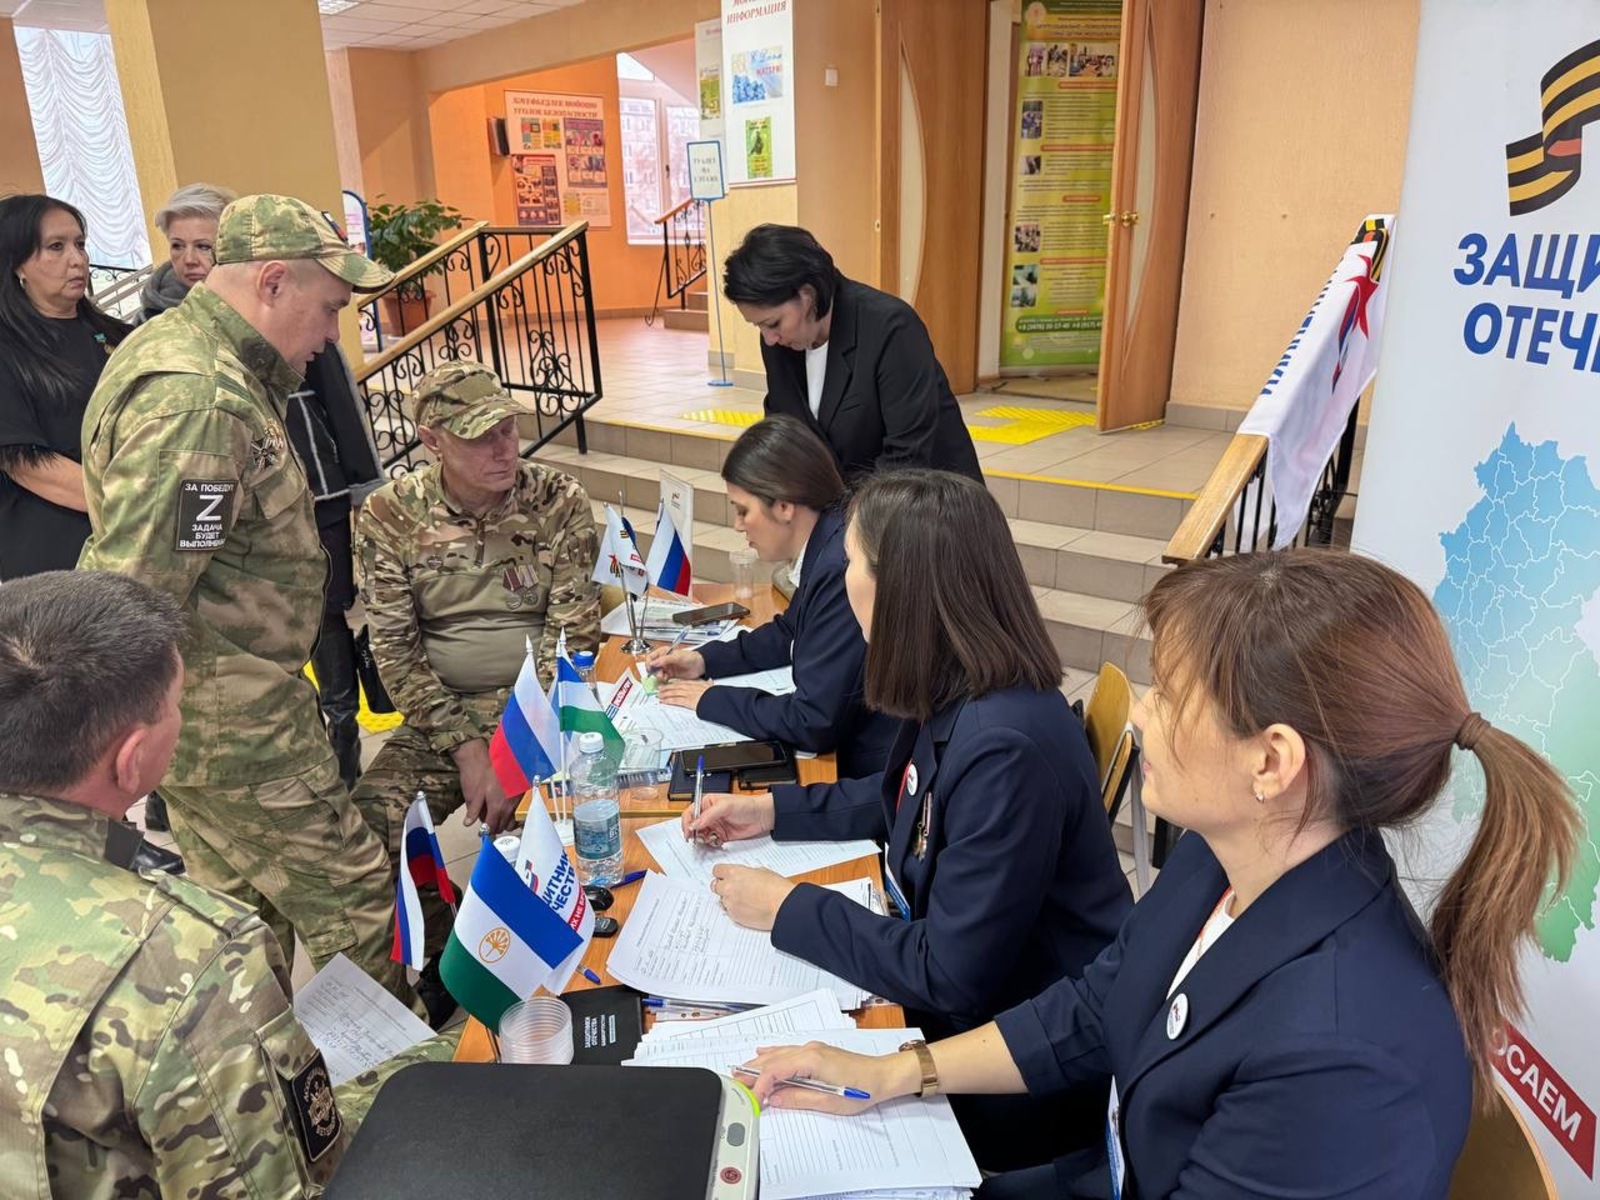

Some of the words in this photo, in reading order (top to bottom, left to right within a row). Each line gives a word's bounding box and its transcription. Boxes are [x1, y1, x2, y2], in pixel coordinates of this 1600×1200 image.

[727, 1, 786, 24] ИНФОРМАЦИЯ
[185, 483, 198, 492] ЗА
[196, 494, 224, 521] Z
[192, 524, 223, 532] ЗАДАЧА
[195, 532, 220, 540] БУДЕТ
